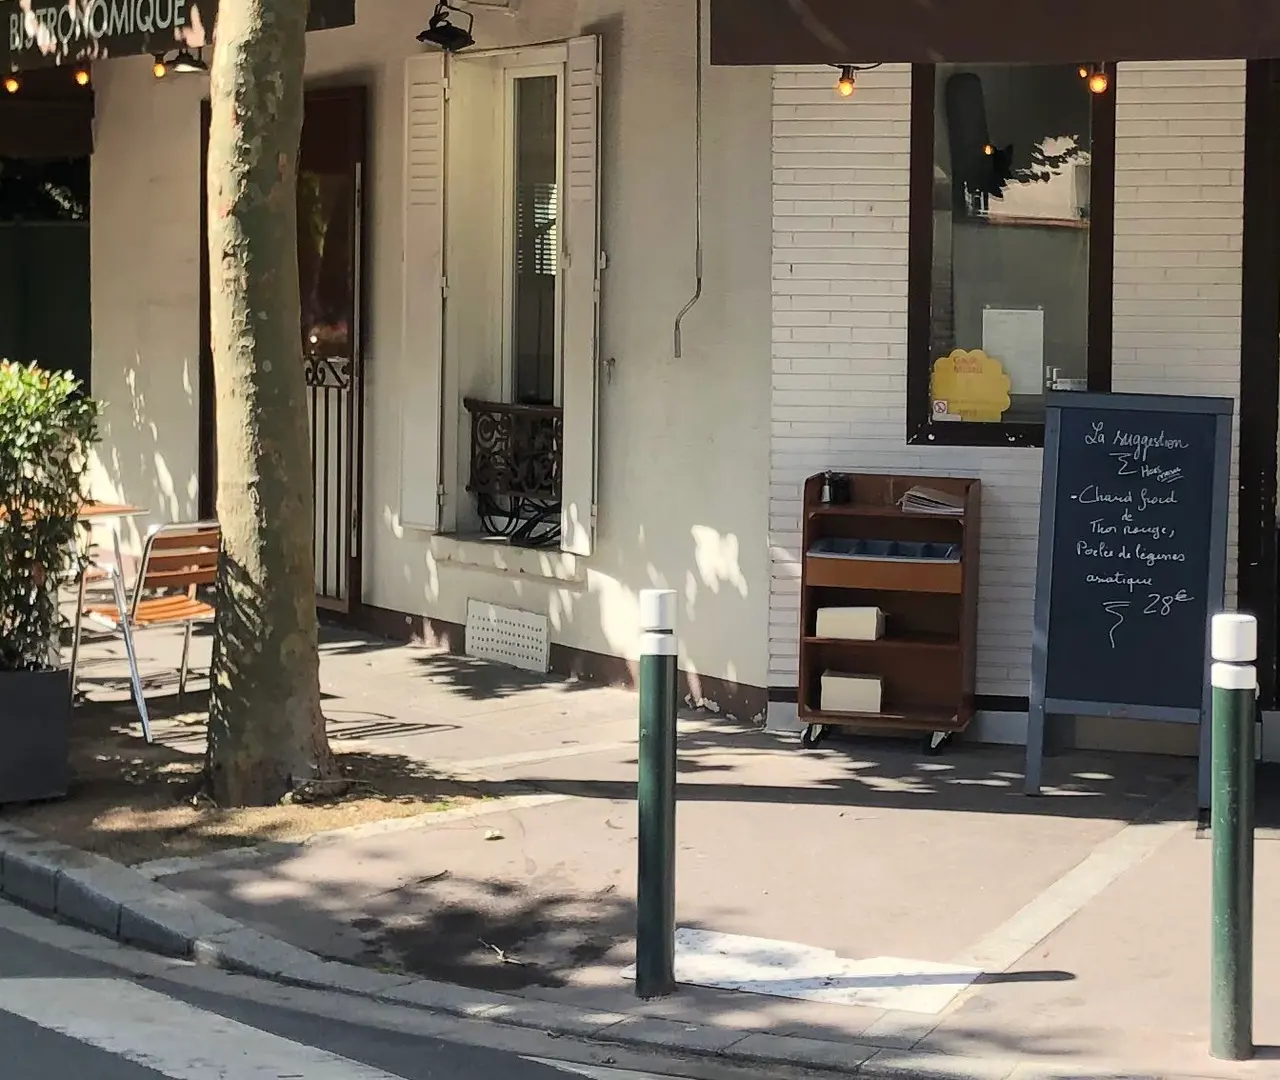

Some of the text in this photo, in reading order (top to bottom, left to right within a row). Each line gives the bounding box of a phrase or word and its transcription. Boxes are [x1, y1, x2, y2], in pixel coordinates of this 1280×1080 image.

[1084, 421, 1190, 461] La suggestion
[1121, 508, 1134, 521] de
[1118, 545, 1132, 559] de
